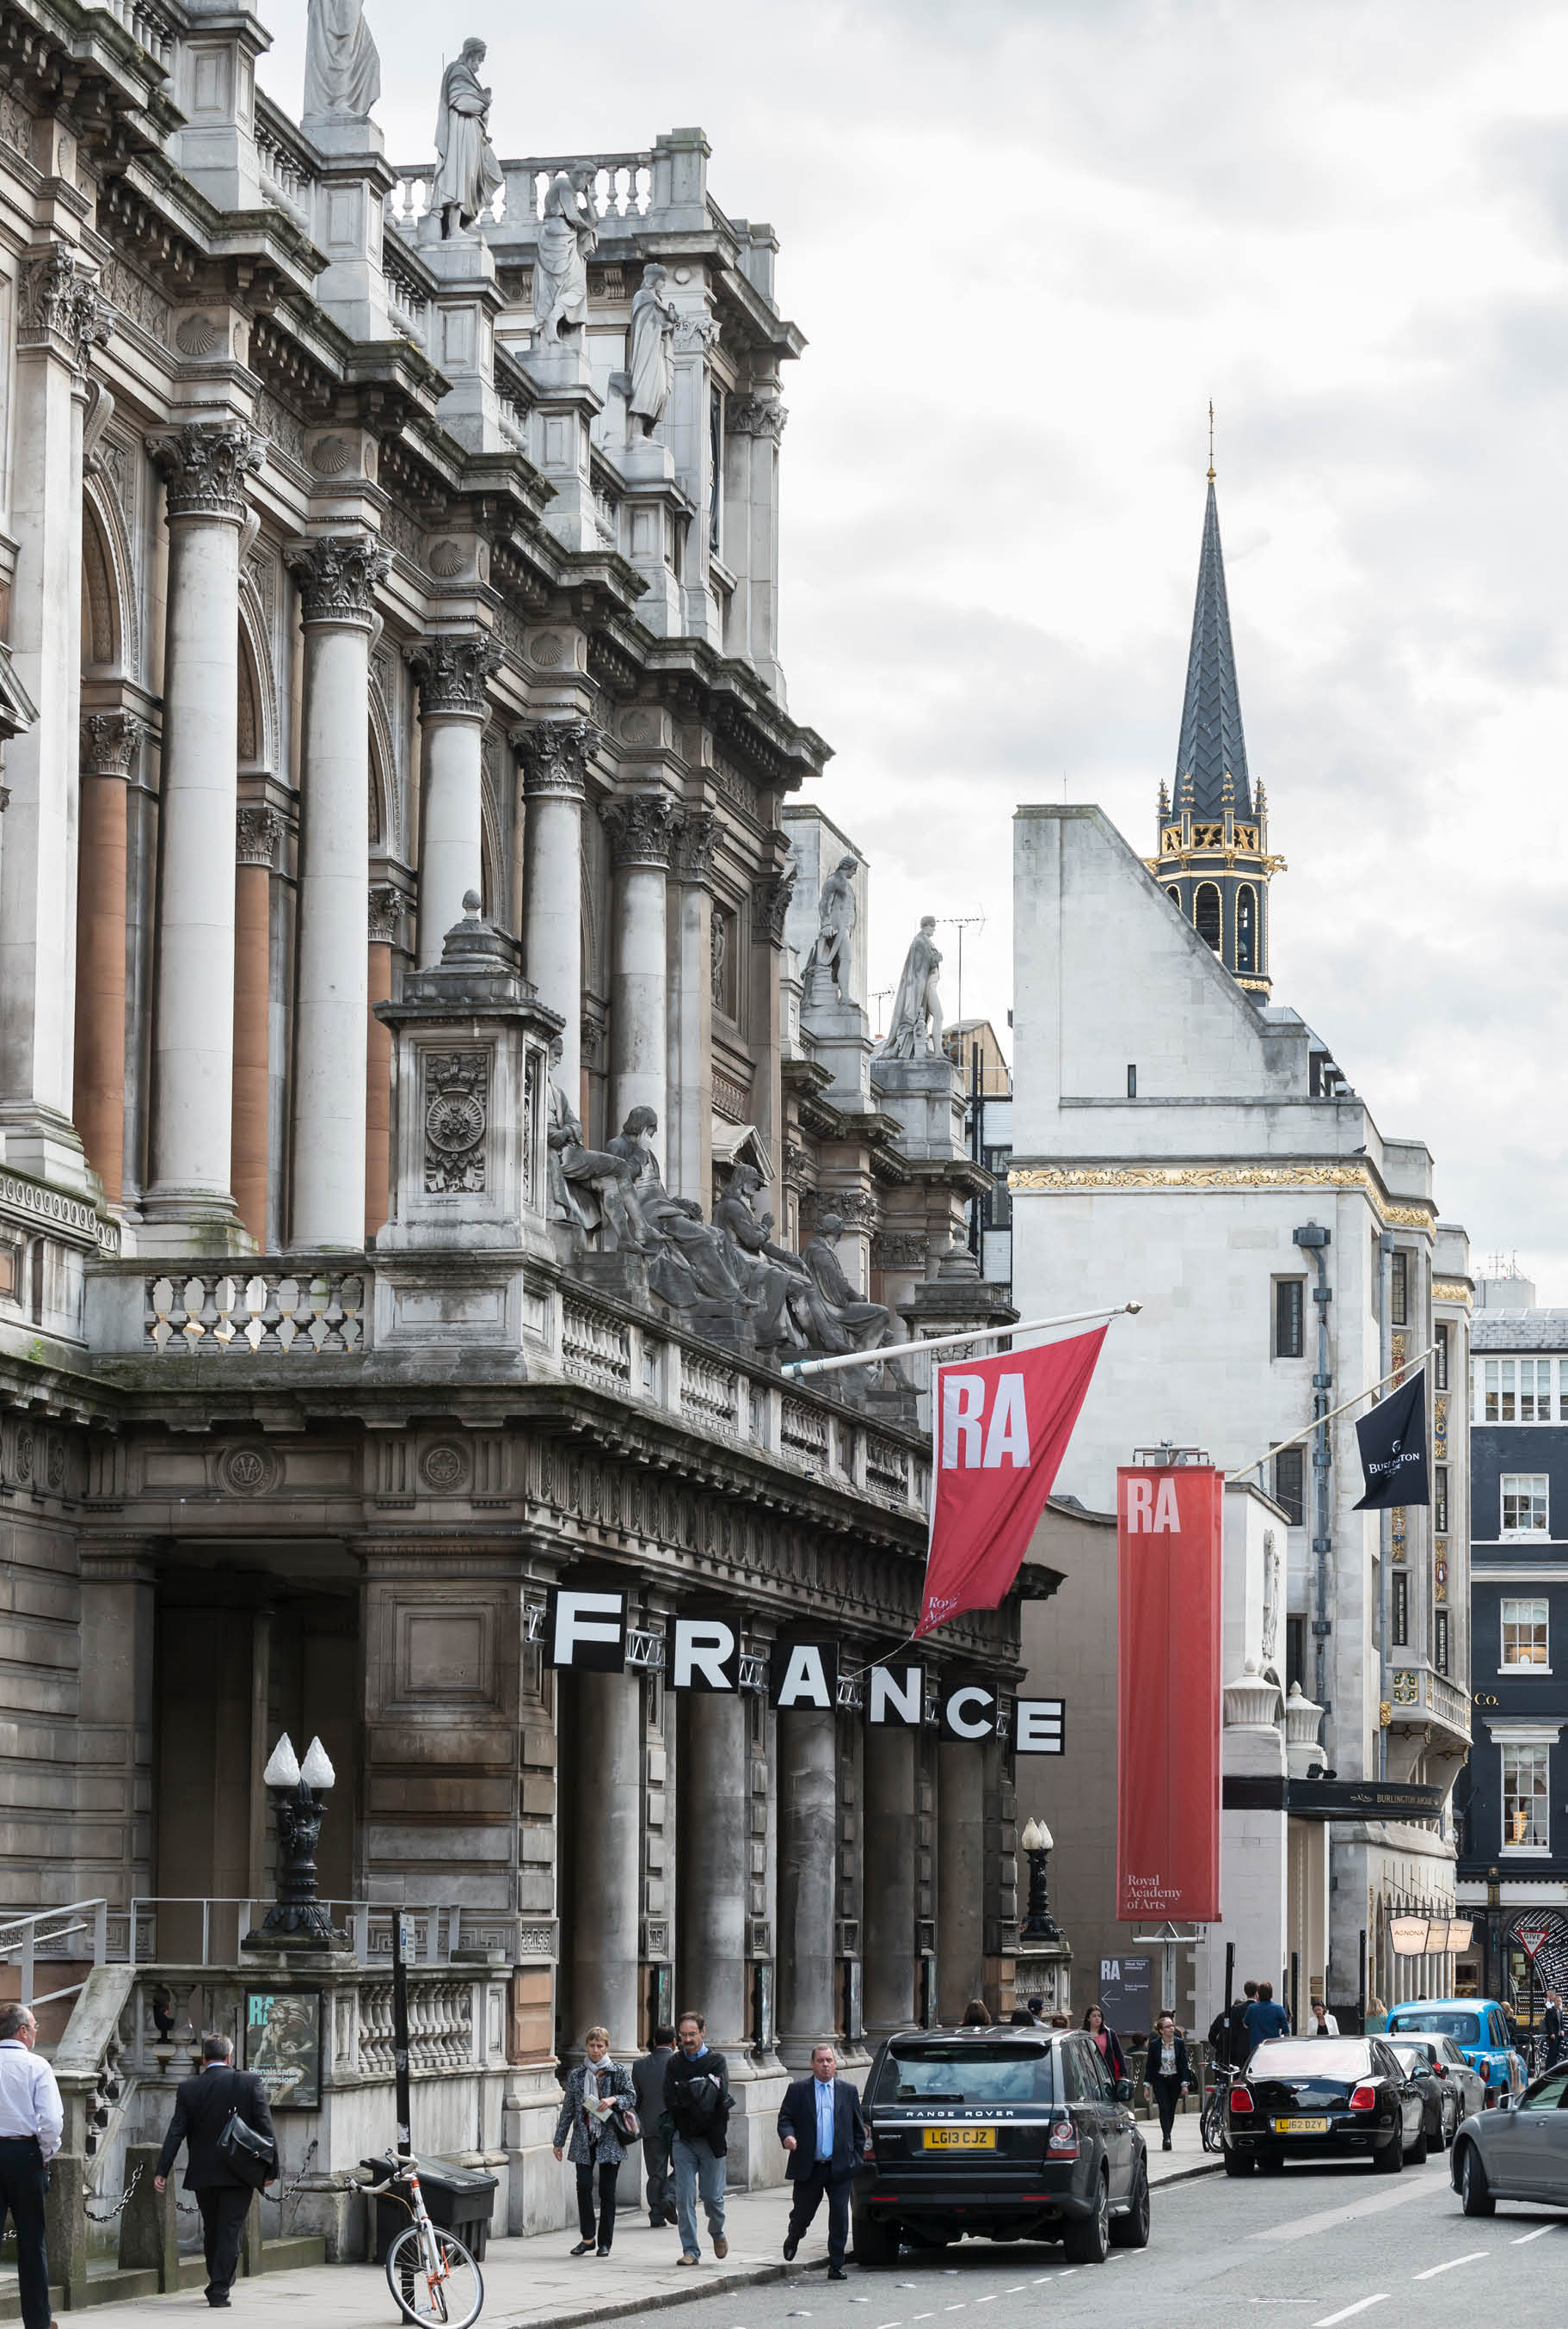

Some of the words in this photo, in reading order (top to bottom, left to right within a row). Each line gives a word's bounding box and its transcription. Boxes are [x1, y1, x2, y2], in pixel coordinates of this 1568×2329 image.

[943, 1373, 1030, 1469] RA
[1127, 1478, 1181, 1533] RA
[553, 1591, 1063, 1753] FRANCE
[1474, 1692, 1499, 1706] Co.
[1376, 1794, 1416, 1804] BURLINGTON
[1128, 1874, 1159, 1889] Royal
[1128, 1886, 1183, 1901] Academy
[1127, 1898, 1140, 1909] of
[1140, 1898, 1165, 1909] Arts
[1101, 1960, 1121, 1980] RA
[260, 2075, 299, 2085] ressions
[932, 2131, 959, 2144] LG13
[962, 2131, 987, 2144] CJZ
